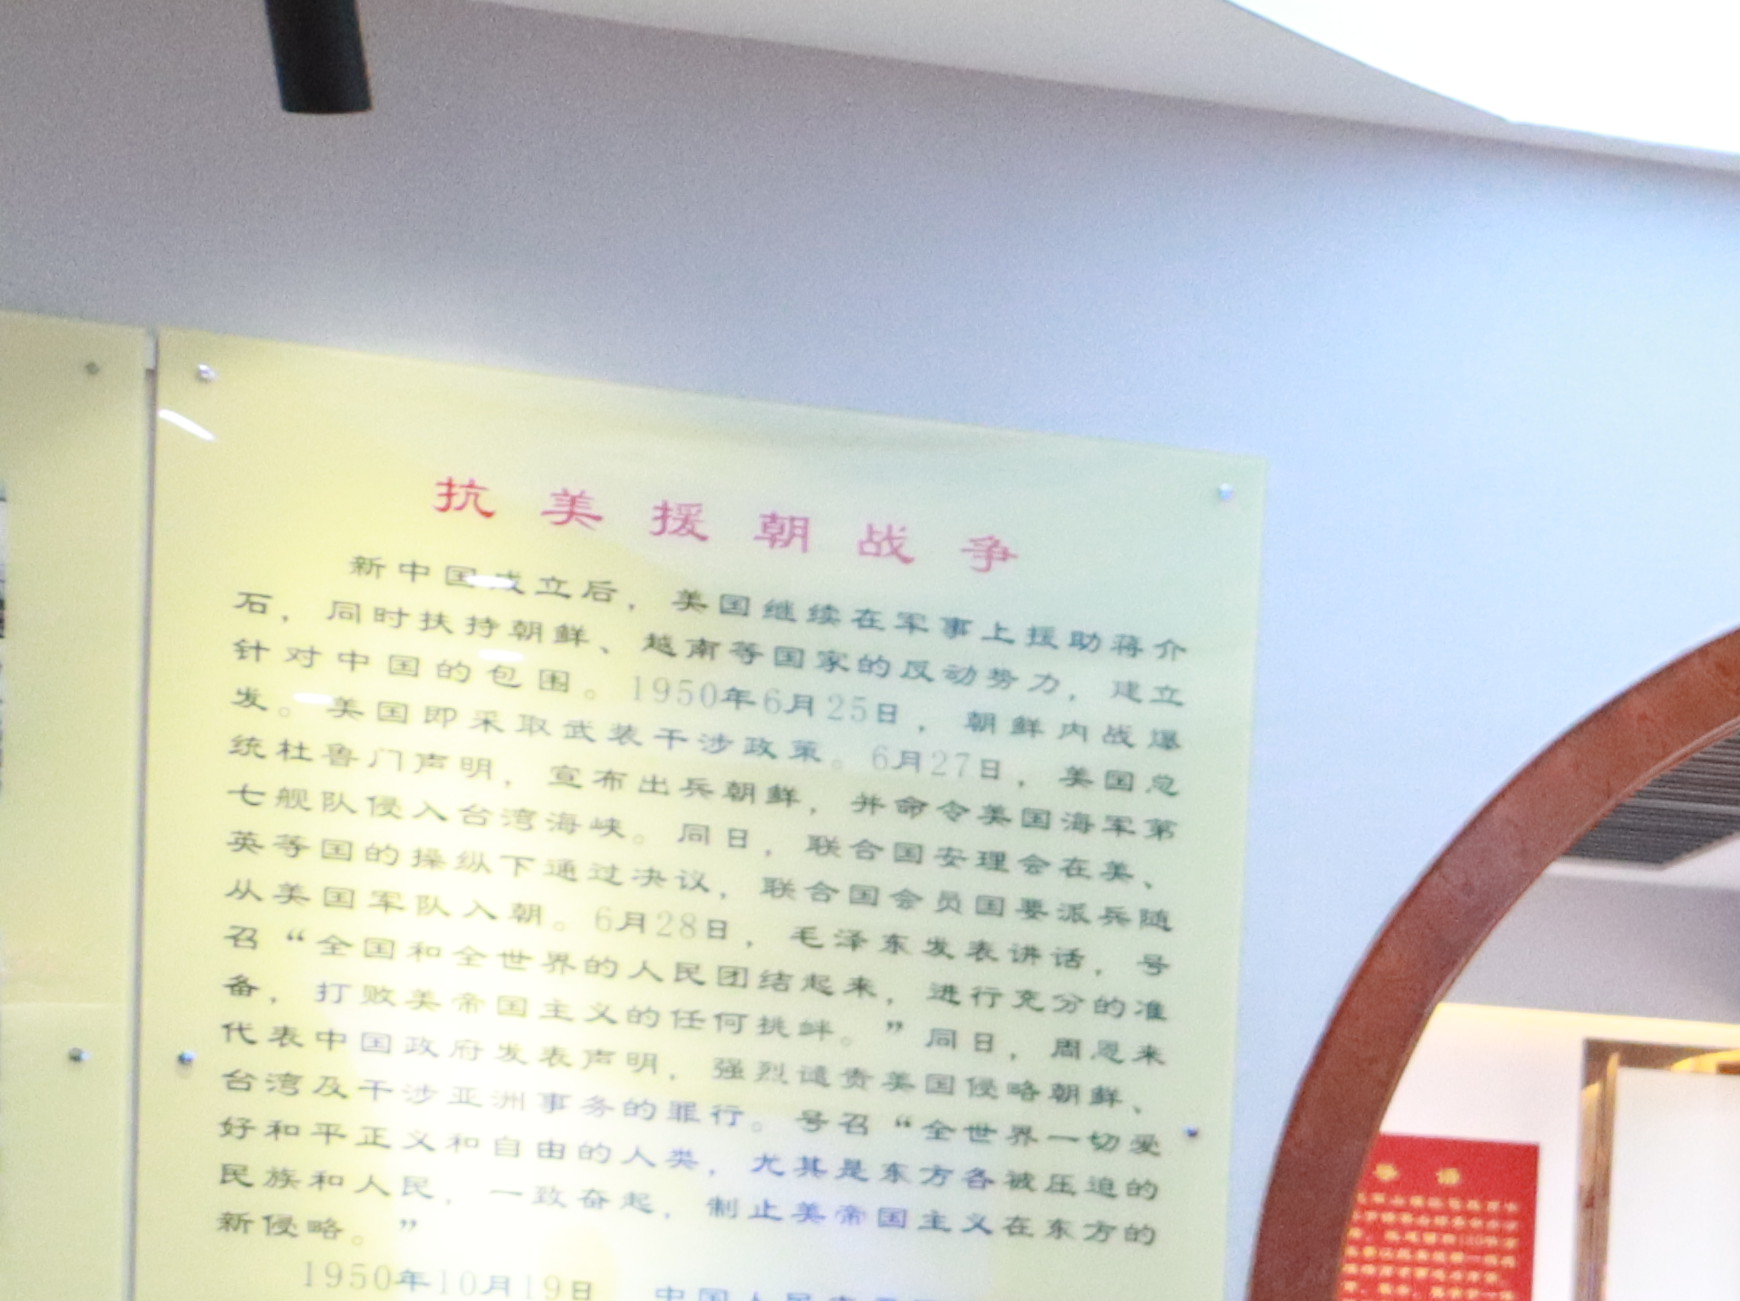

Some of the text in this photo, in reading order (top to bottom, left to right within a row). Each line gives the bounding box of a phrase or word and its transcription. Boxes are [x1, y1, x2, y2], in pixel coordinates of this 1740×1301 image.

[432, 477, 1019, 573] 抗美援朝战争
